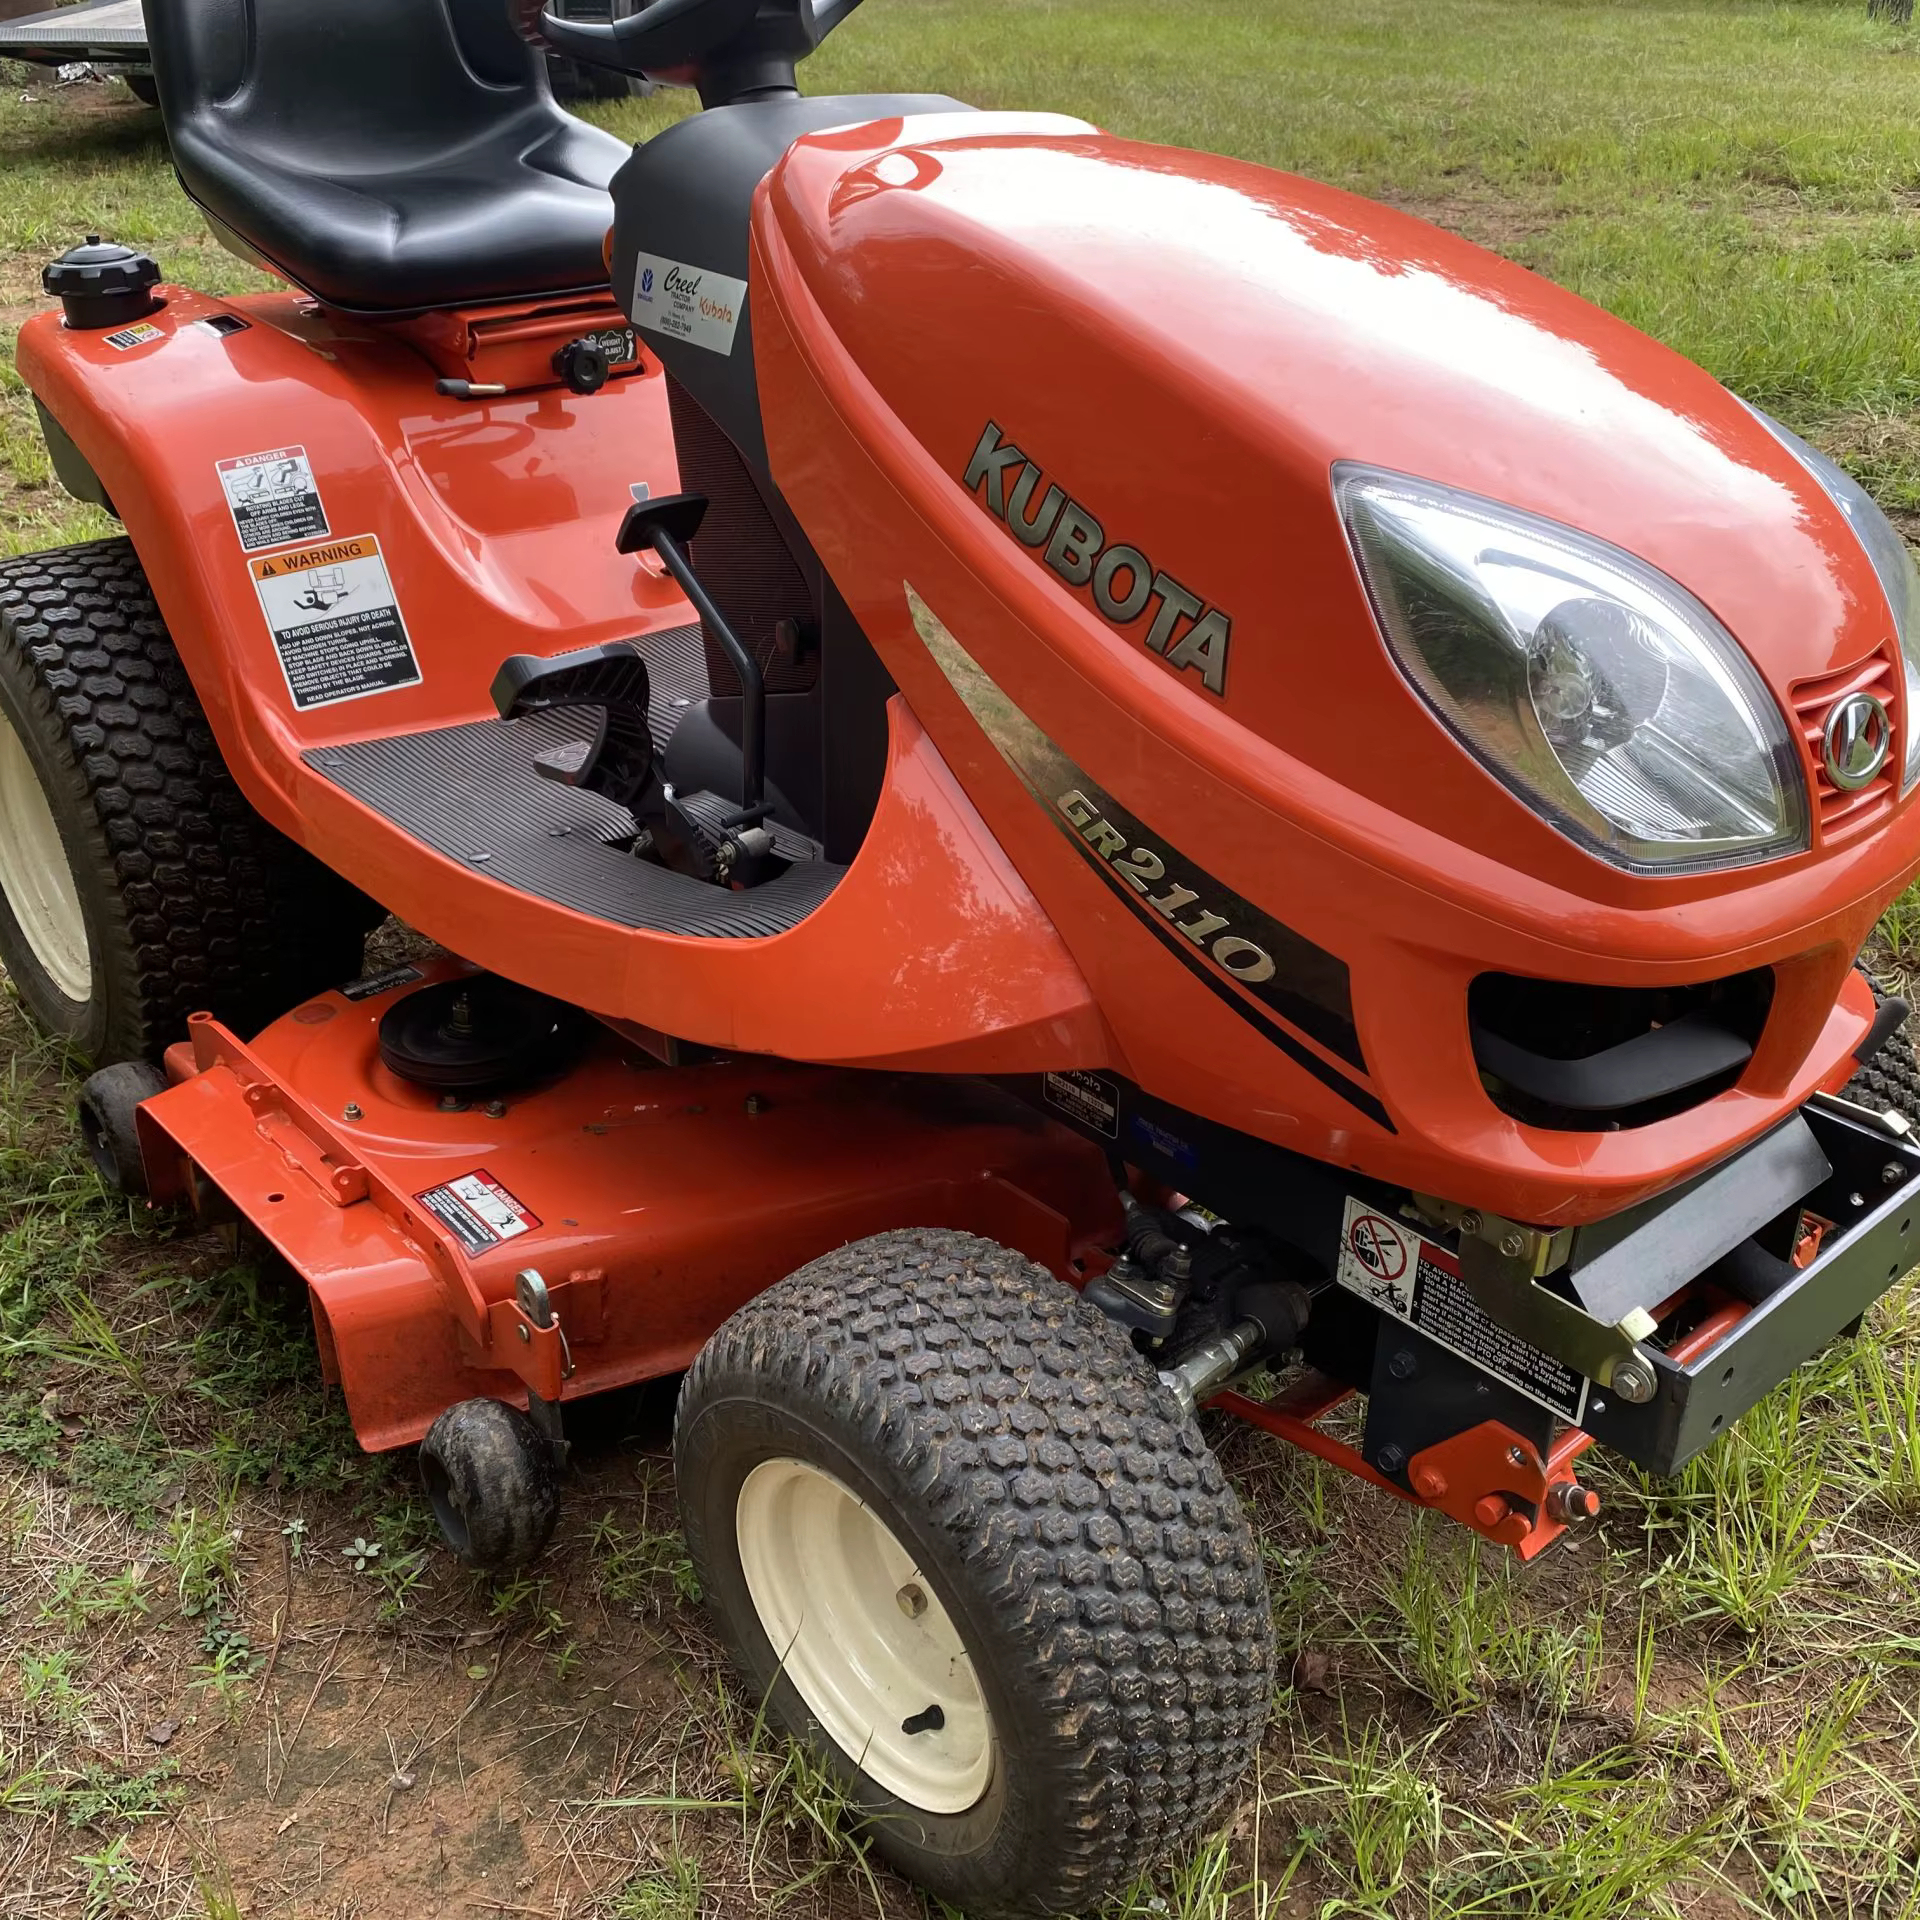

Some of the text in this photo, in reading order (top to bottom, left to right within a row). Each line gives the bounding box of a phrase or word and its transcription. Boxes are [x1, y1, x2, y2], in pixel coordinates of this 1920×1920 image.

[664, 266, 702, 295] Creel
[671, 291, 690, 304] TRACTOR
[673, 300, 694, 313] COMPANY
[700, 296, 732, 323] Kubota
[601, 338, 621, 347] WEIGHT
[605, 346, 621, 356] DJUST
[245, 451, 287, 465] DANGER
[246, 502, 272, 512] ROTATING
[272, 498, 294, 507] BLADES
[282, 542, 362, 570] WARNING
[962, 418, 1232, 698] KUBOTA
[281, 608, 391, 640] TO AVOID SERIOUS INJURY OR DEATH
[292, 650, 320, 661] MACHINE
[319, 646, 340, 655] STOPS
[339, 641, 359, 650] GOING
[301, 638, 315, 646] AND
[314, 633, 333, 642] DOWN
[302, 642, 327, 652] SUDDEN
[288, 661, 304, 669] STOP
[304, 656, 325, 665] BLADE
[325, 653, 338, 661] AND
[338, 649, 355, 657] BACK
[355, 645, 374, 654] DOWN
[293, 674, 306, 682] AND
[345, 660, 365, 669] PLACE
[365, 657, 379, 665] AND
[307, 662, 330, 672] SAFETY
[330, 656, 356, 666] DEVICES
[383, 644, 408, 654] SHIELDS
[319, 671, 347, 683] OBJECTS
[347, 668, 363, 676] THAT
[362, 663, 384, 672] COULD
[297, 684, 323, 695] THROWN
[307, 694, 324, 703] READ
[324, 685, 361, 698] OPERATOR'S
[1057, 789, 1276, 982] GR2110
[493, 1188, 526, 1215] DANGER
[1418, 1265, 1440, 1282] FROM
[1441, 1278, 1447, 1286] A
[1449, 1283, 1476, 1303] MACH
[1419, 1258, 1456, 1284] TO AVOID
[1424, 1276, 1434, 1286] Do
[1435, 1282, 1447, 1294] not
[1449, 1290, 1465, 1304] start
[1420, 1312, 1462, 1341] transmission
[1463, 1337, 1476, 1350] and
[1477, 1345, 1491, 1359] PTO
[1421, 1298, 1440, 1314] move
[1447, 1313, 1471, 1332] normal
[1472, 1328, 1500, 1350] starting
[1501, 1345, 1530, 1368] circuitry
[1531, 1362, 1539, 1371] is
[1422, 1290, 1571, 1381] start switch. Machine may start in gear and
[1423, 1283, 1446, 1302] starter
[1447, 1297, 1479, 1320] terminals
[1489, 1321, 1527, 1349] bypassing
[1528, 1343, 1540, 1355] the
[1540, 1351, 1564, 1370] safety
[1418, 1318, 1436, 1334] Never
[1437, 1329, 1453, 1344] start
[1453, 1339, 1475, 1358] engine
[1476, 1352, 1493, 1368] while
[1494, 1363, 1523, 1387] standing
[1524, 1381, 1534, 1392] on
[1534, 1387, 1546, 1399] the
[1420, 1305, 1437, 1319] Start
[1437, 1315, 1461, 1335] engine
[1462, 1329, 1477, 1344] only
[1478, 1339, 1495, 1353] from
[1496, 1349, 1533, 1377] operator's
[1534, 1371, 1550, 1385] seat
[1551, 1381, 1567, 1395] with
